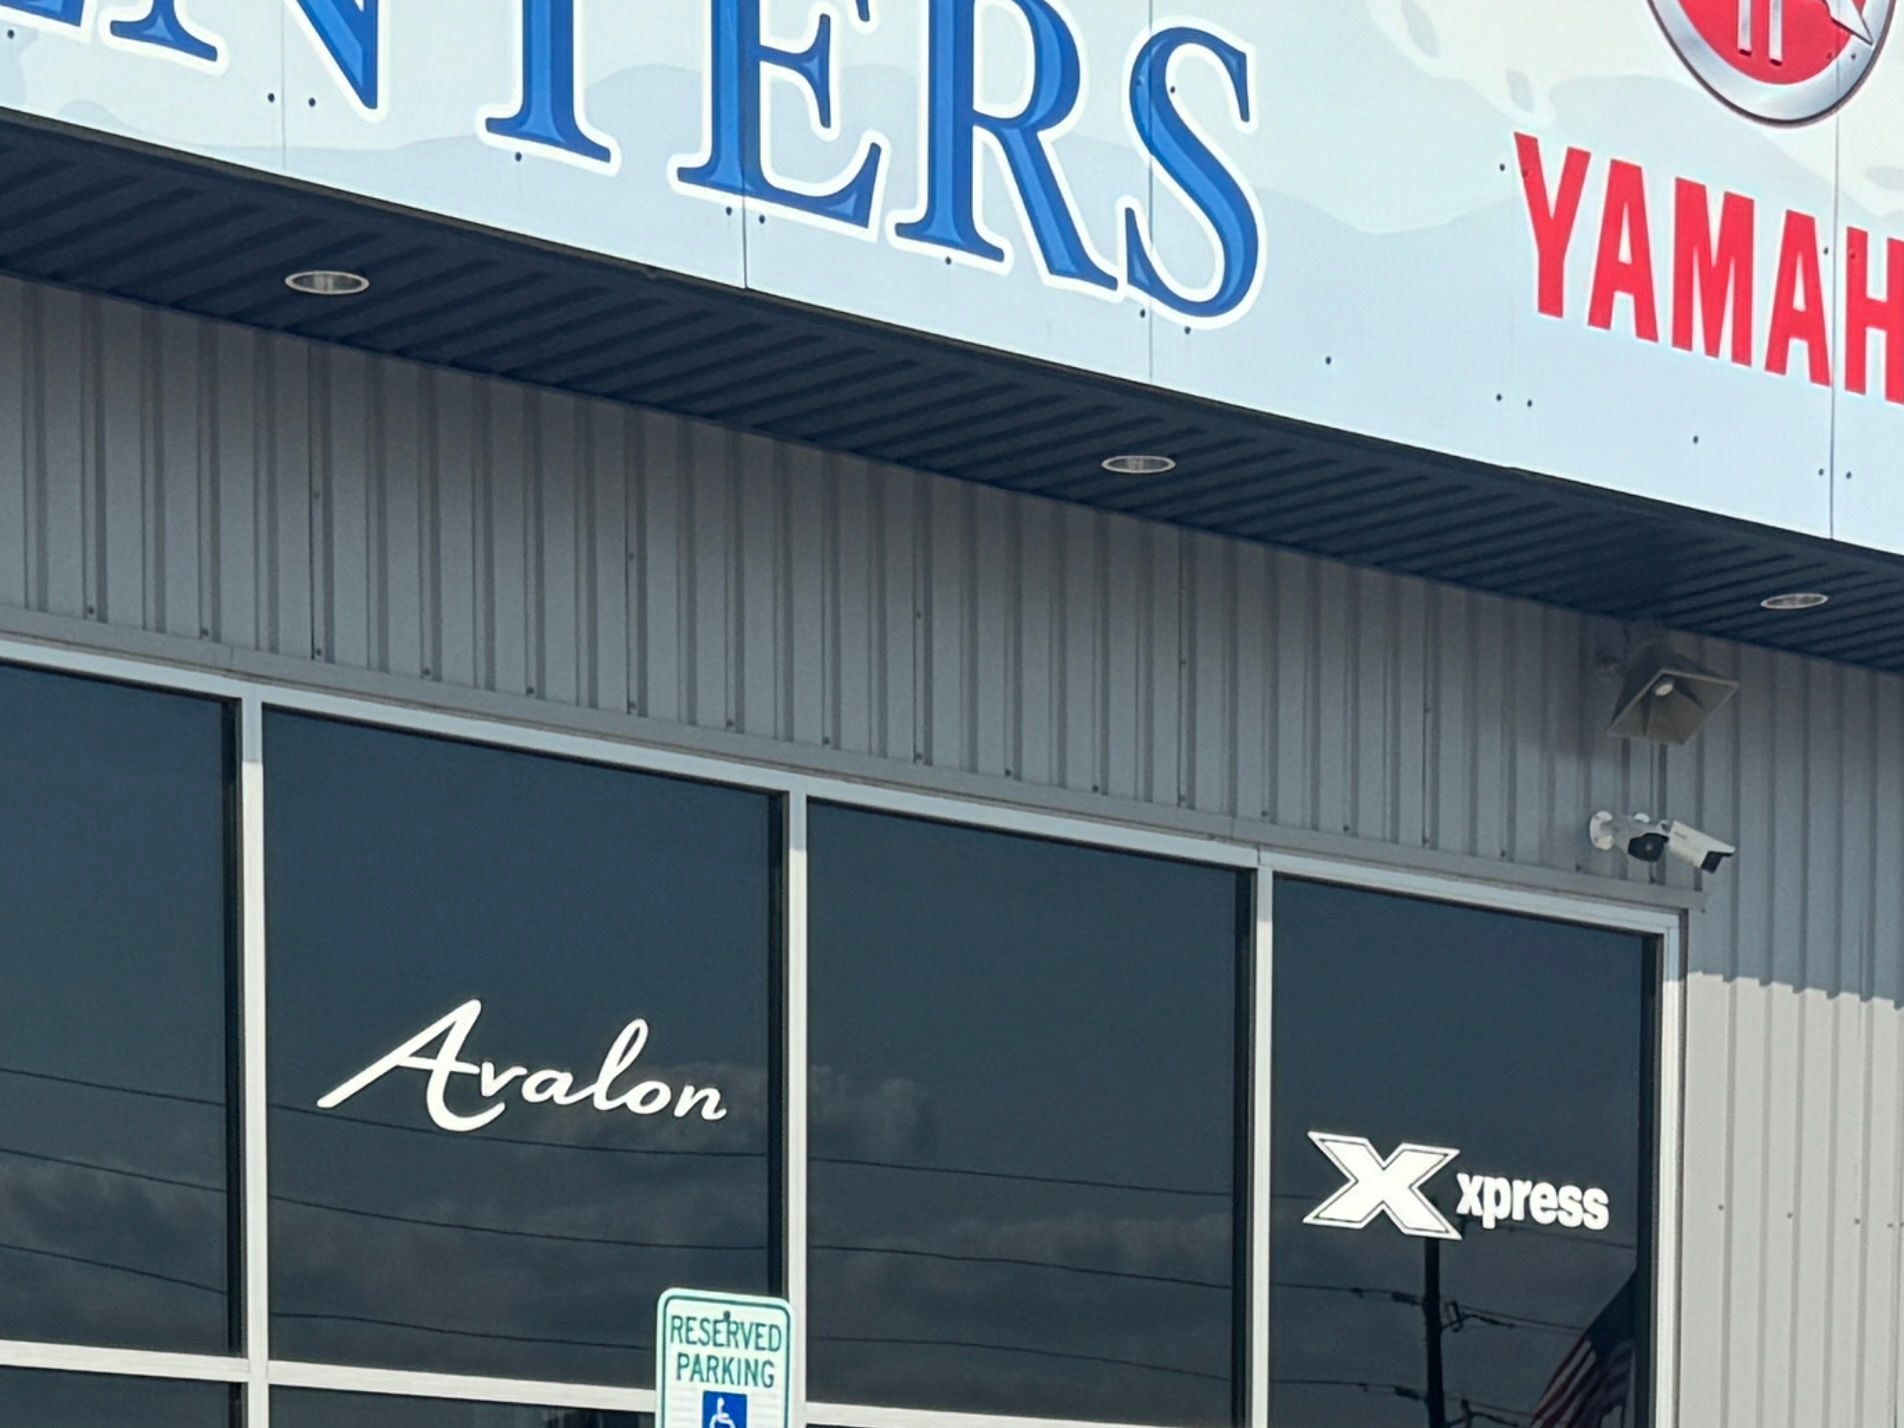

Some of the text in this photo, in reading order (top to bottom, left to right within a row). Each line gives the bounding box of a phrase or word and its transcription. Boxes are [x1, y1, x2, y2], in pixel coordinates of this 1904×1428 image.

[316, 999, 727, 1131] Avalon
[1456, 1172, 1609, 1230] xpress
[670, 1315, 782, 1352] RESERVED
[676, 1352, 776, 1388] PARKING
